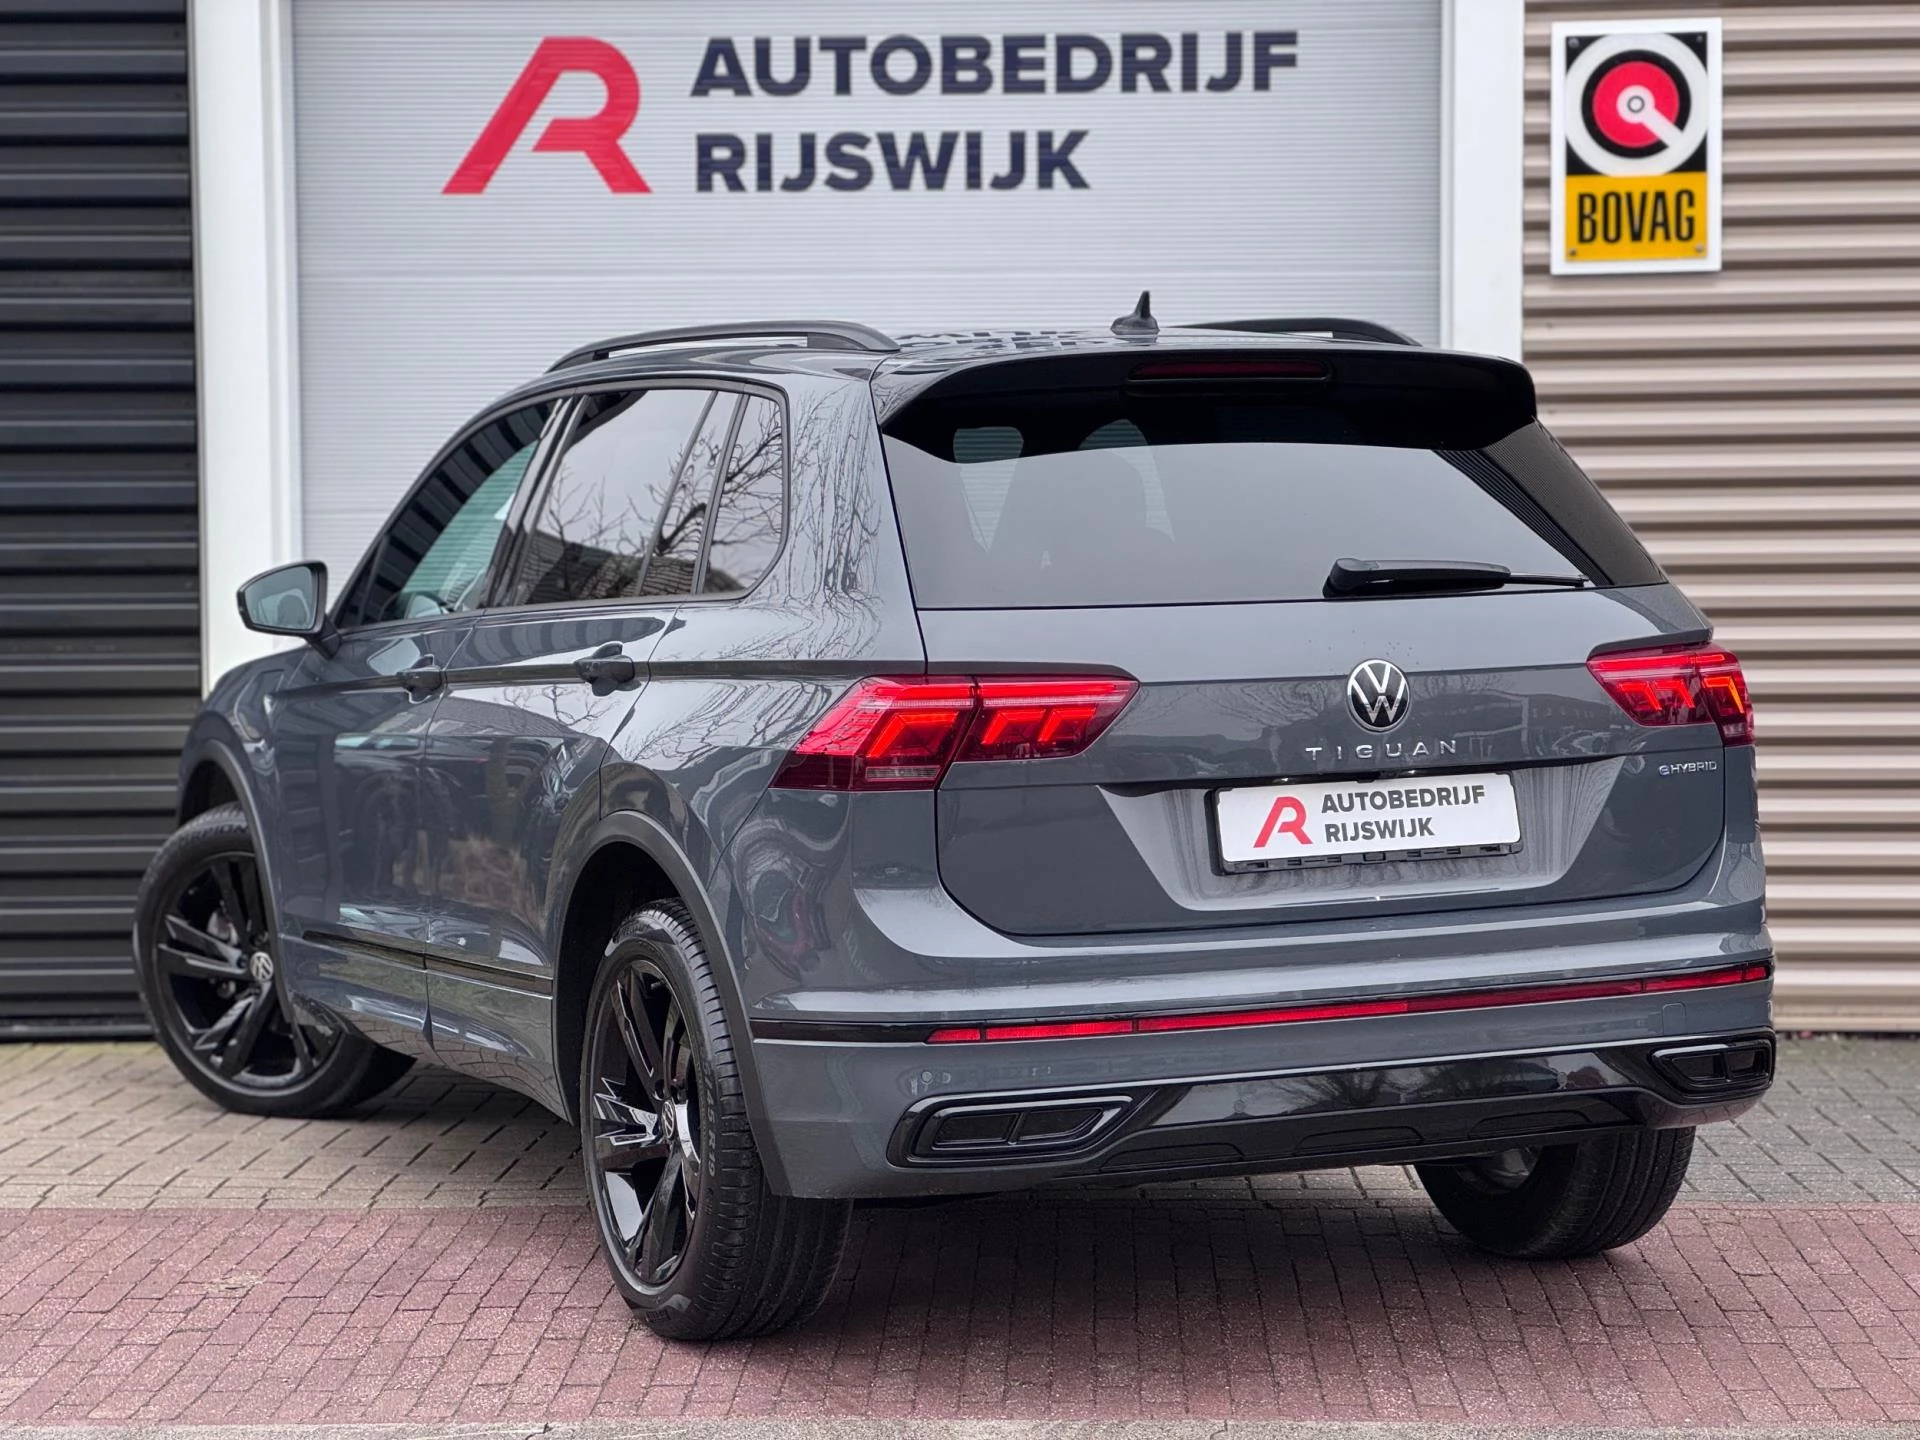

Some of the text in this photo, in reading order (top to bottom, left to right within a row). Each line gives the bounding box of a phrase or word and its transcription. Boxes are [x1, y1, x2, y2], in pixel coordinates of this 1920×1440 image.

[690, 31, 1298, 96] AUTOBEDRIJF
[696, 130, 1090, 192] RIJSWIJK
[1578, 189, 1695, 243] BOVAG
[1305, 740, 1456, 760] TIGUAN
[1321, 785, 1486, 813] AUTOBEDRIJF
[1324, 817, 1435, 842] RIJSWIJK
